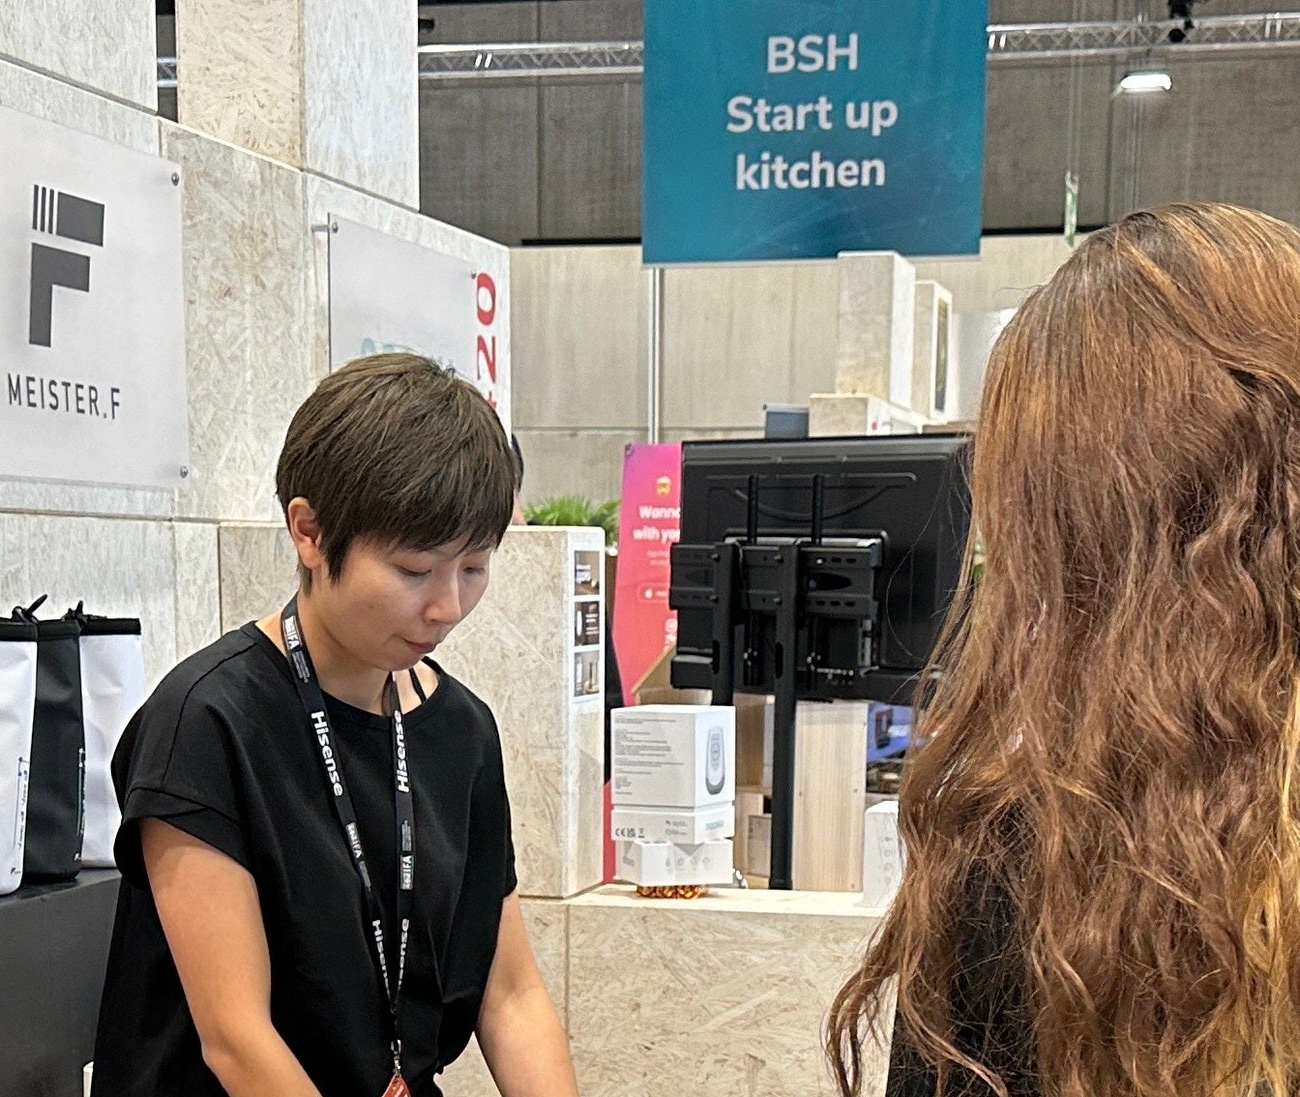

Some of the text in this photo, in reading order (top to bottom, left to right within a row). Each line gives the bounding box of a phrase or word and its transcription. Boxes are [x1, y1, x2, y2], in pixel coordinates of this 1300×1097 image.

[766, 32, 859, 74] BSH
[726, 95, 899, 137] Start up
[735, 150, 886, 191] kitchen
[476, 272, 497, 410] 20
[6, 371, 123, 423] MEISTER.F
[633, 527, 660, 541] with
[310, 710, 344, 798] Hisense
[393, 709, 410, 794] Hisense
